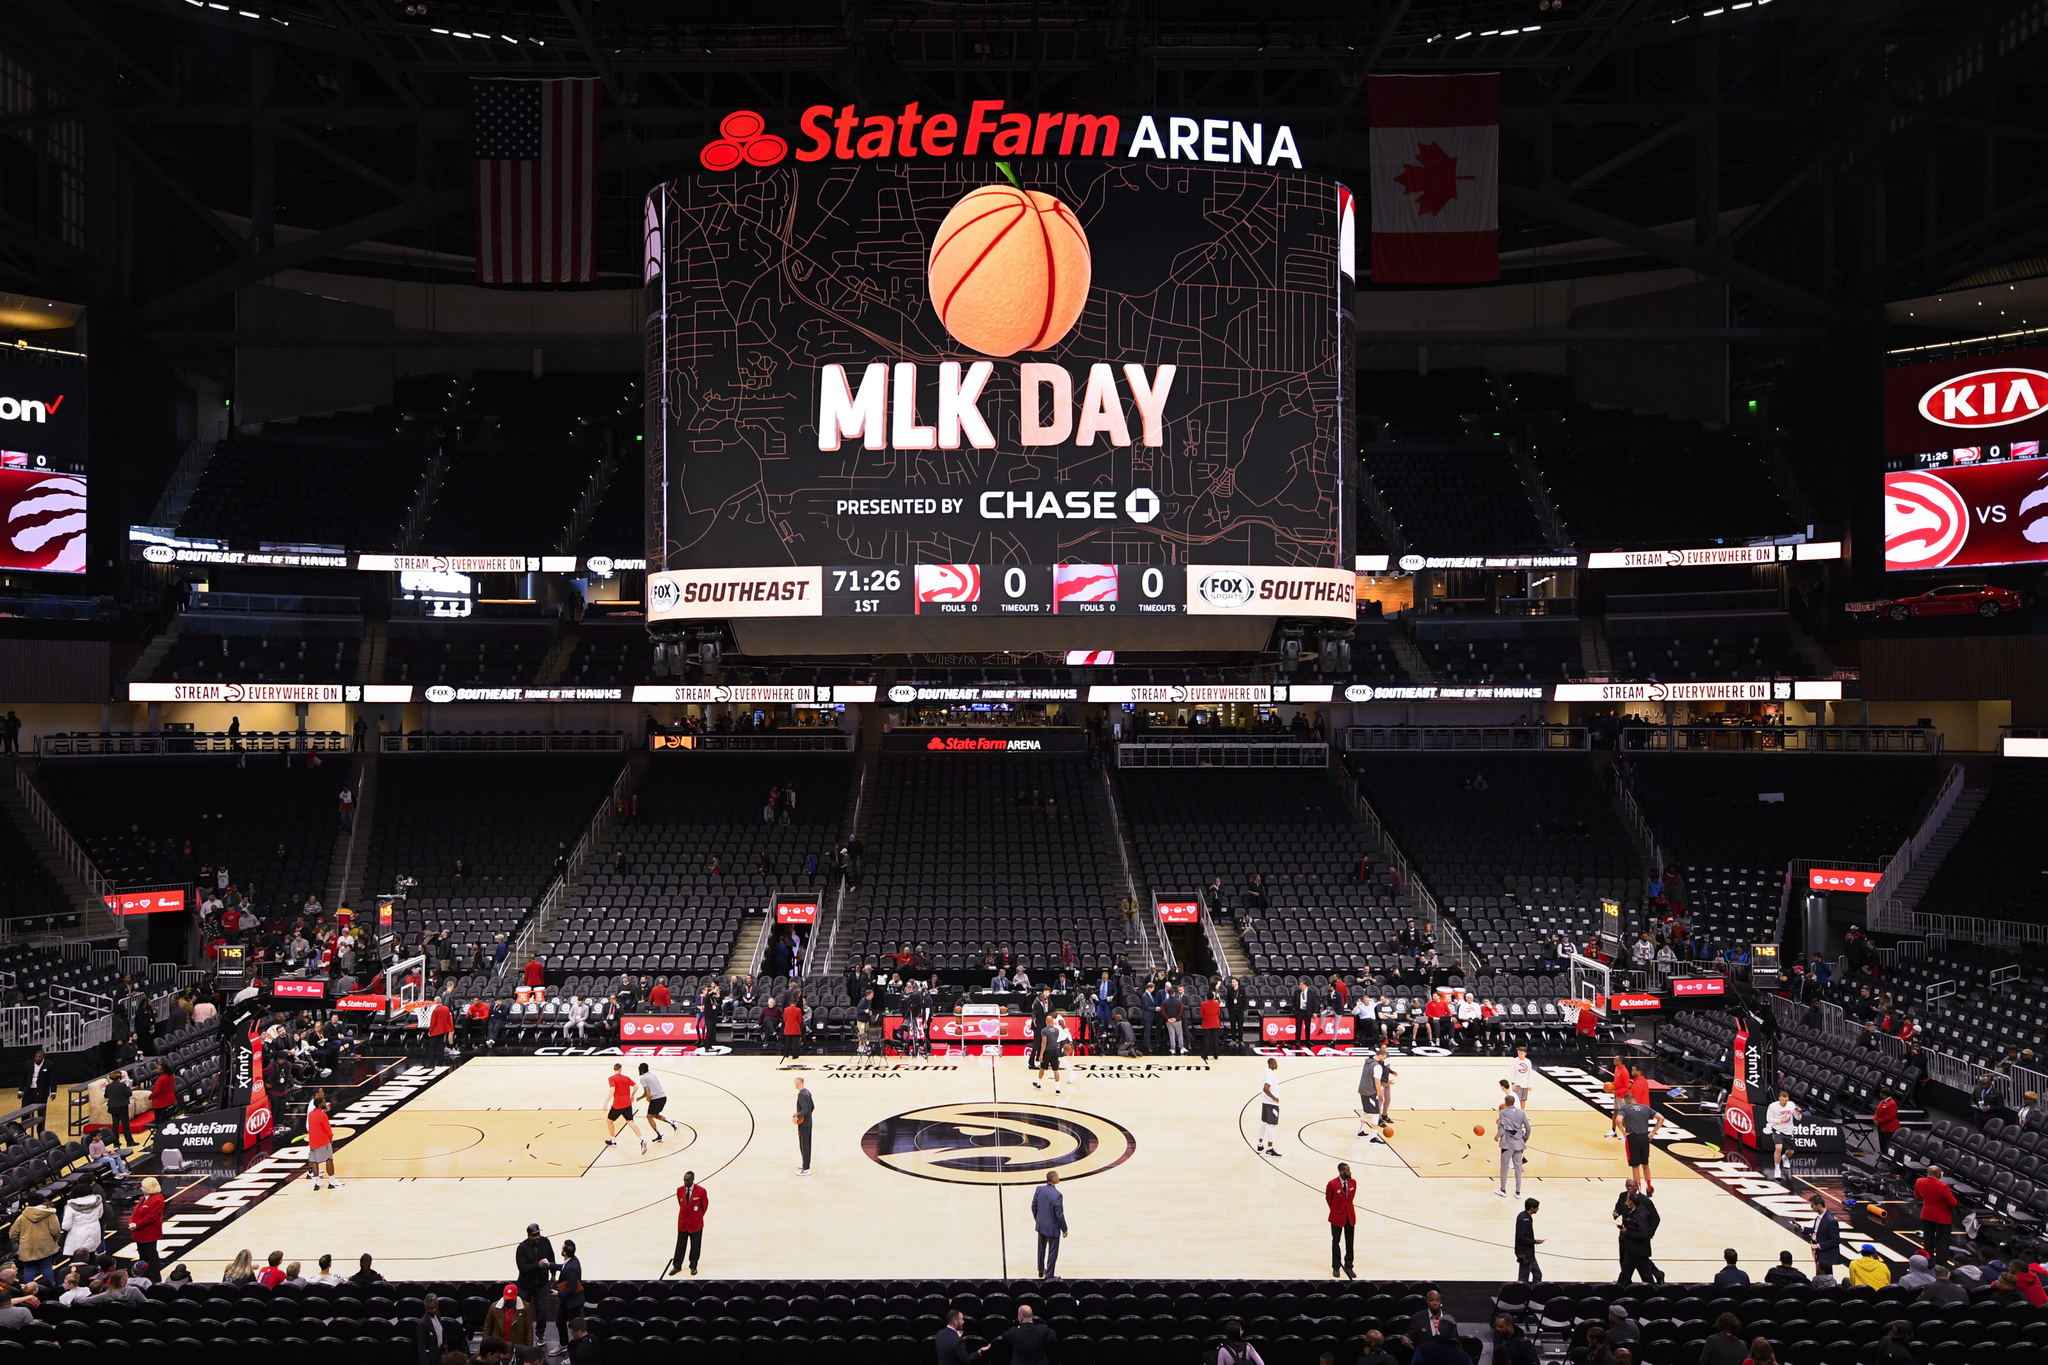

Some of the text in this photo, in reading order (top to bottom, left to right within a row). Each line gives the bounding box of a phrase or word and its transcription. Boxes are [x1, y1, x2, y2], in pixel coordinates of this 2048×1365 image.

[1127, 114, 1303, 169] ARENA
[1942, 378, 2040, 420] KIA
[818, 361, 1178, 452] MLK DAY
[1919, 451, 1949, 463] 71:26
[836, 498, 963, 515] PRESENTED BY
[979, 491, 1118, 519] CHASE
[1975, 505, 2007, 524] VS
[394, 558, 429, 570] STREAM
[452, 558, 508, 570] EVERYWHERE
[510, 558, 521, 570] ON
[1625, 554, 1662, 566] STREAM
[1688, 550, 1752, 563] EVERYWHERE
[1756, 548, 1770, 560] ON
[832, 570, 901, 592] 71:26
[1004, 568, 1027, 598] 0
[1142, 568, 1164, 598] 0
[1211, 579, 1242, 593] FOX
[654, 584, 671, 598] FOX
[684, 581, 810, 603] SOUTHEAST
[1260, 580, 1354, 604] SOUTHEAST
[653, 598, 672, 606] SPORTS
[854, 600, 880, 612] 1ST
[942, 604, 978, 612] FOULS 0
[1000, 604, 1050, 612] TIMEOUTS 7
[1080, 604, 1116, 612] FOULS 0
[1138, 604, 1176, 612] TIMEOUTS
[175, 686, 220, 699] STREAM
[249, 686, 320, 700] EVERYWHERE
[323, 687, 338, 700] ON
[524, 690, 548, 699] HOME
[550, 690, 561, 699] OF
[561, 690, 576, 699] THE
[576, 689, 622, 699] HAWKS
[676, 688, 711, 700] STREAM
[734, 688, 794, 700] EVERYWHERE
[798, 688, 810, 700] ON
[982, 690, 1005, 698] HOME
[1005, 690, 1016, 698] OF
[1017, 690, 1032, 698] THE
[1032, 689, 1077, 699] HAWKS
[1131, 688, 1167, 700] STREAM
[1191, 688, 1250, 700] EVERYWHERE
[1254, 687, 1266, 700] ON
[1440, 689, 1464, 698] HOME
[1465, 689, 1476, 698] OF
[1477, 688, 1493, 697] THE
[1493, 687, 1542, 698] HAWKS
[1603, 686, 1644, 699] STREAM
[1672, 685, 1745, 699] EVERYWHERE
[1749, 684, 1765, 698] ON
[1632, 708, 1683, 718] HAWS
[1007, 740, 1041, 750] ARENA
[534, 1047, 687, 1056] CHASE
[236, 1046, 252, 1088] xfinity
[1745, 1045, 1760, 1088] xfinity
[250, 1112, 266, 1131] KIA
[1730, 1110, 1748, 1130] KIA
[183, 1137, 214, 1146] ARENA
